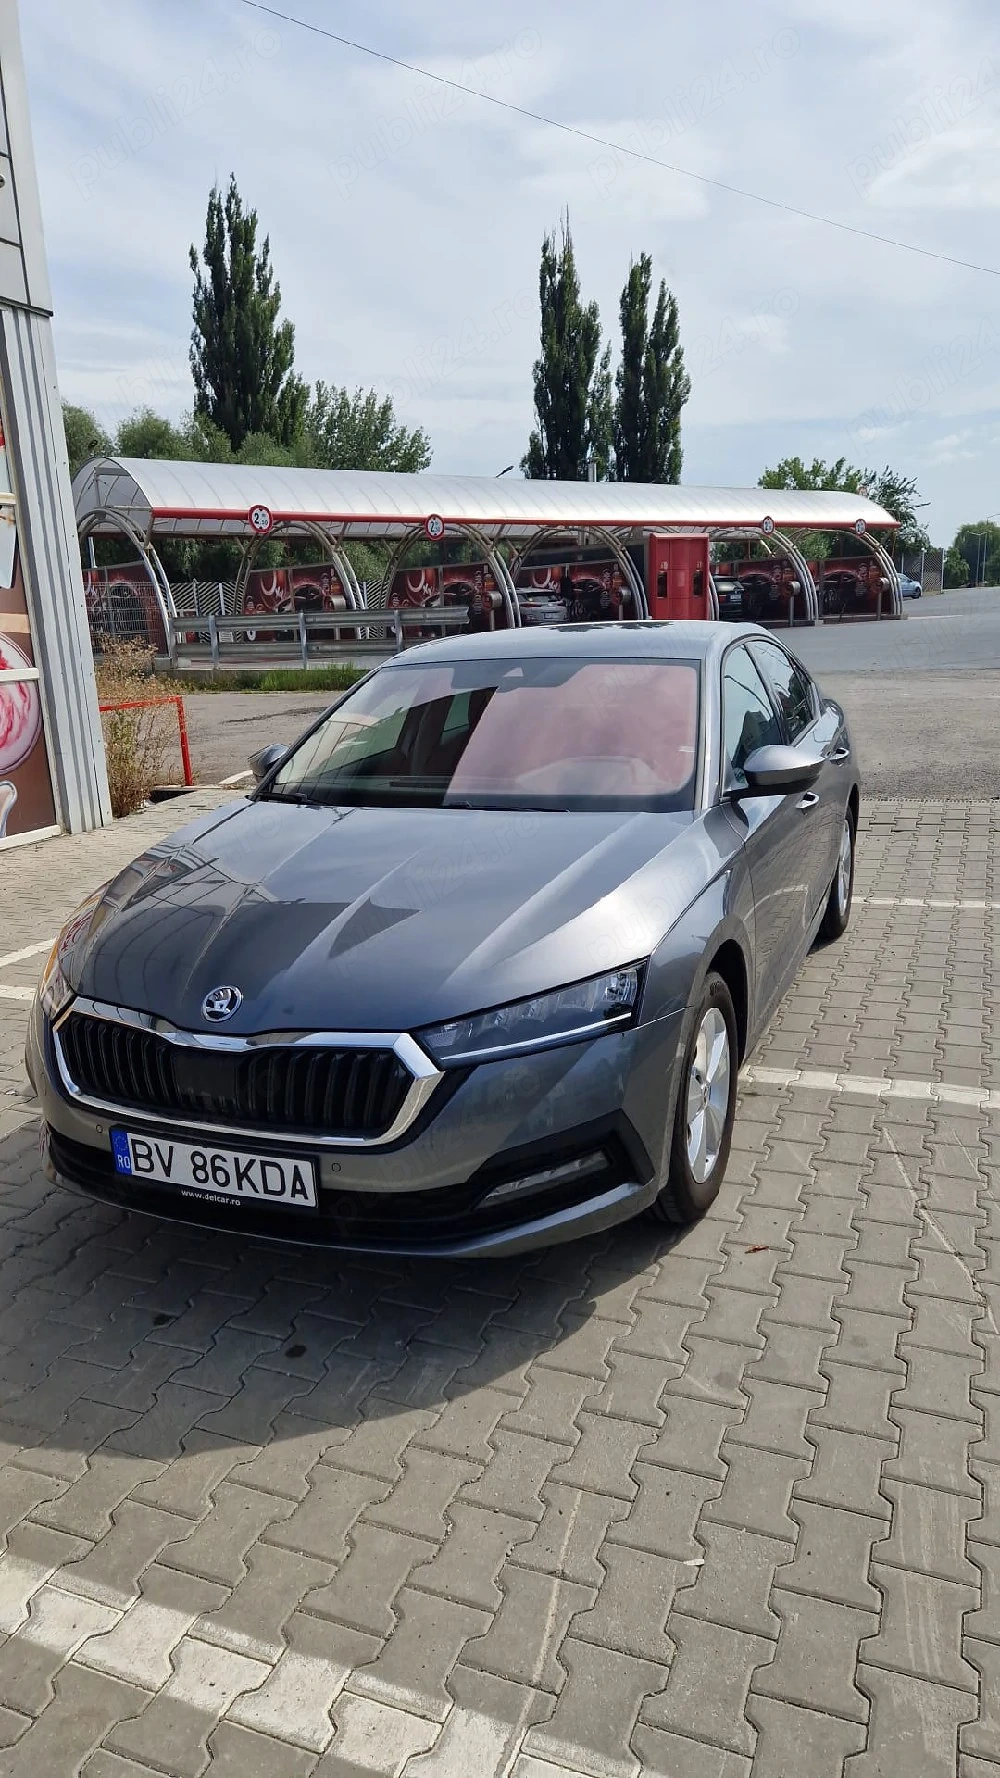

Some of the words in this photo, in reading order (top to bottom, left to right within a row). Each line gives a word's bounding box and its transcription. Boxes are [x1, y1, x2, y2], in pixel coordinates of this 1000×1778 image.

[117, 1154, 131, 1169] RO
[130, 1138, 174, 1178] BV
[190, 1150, 309, 1201] 86KDA
